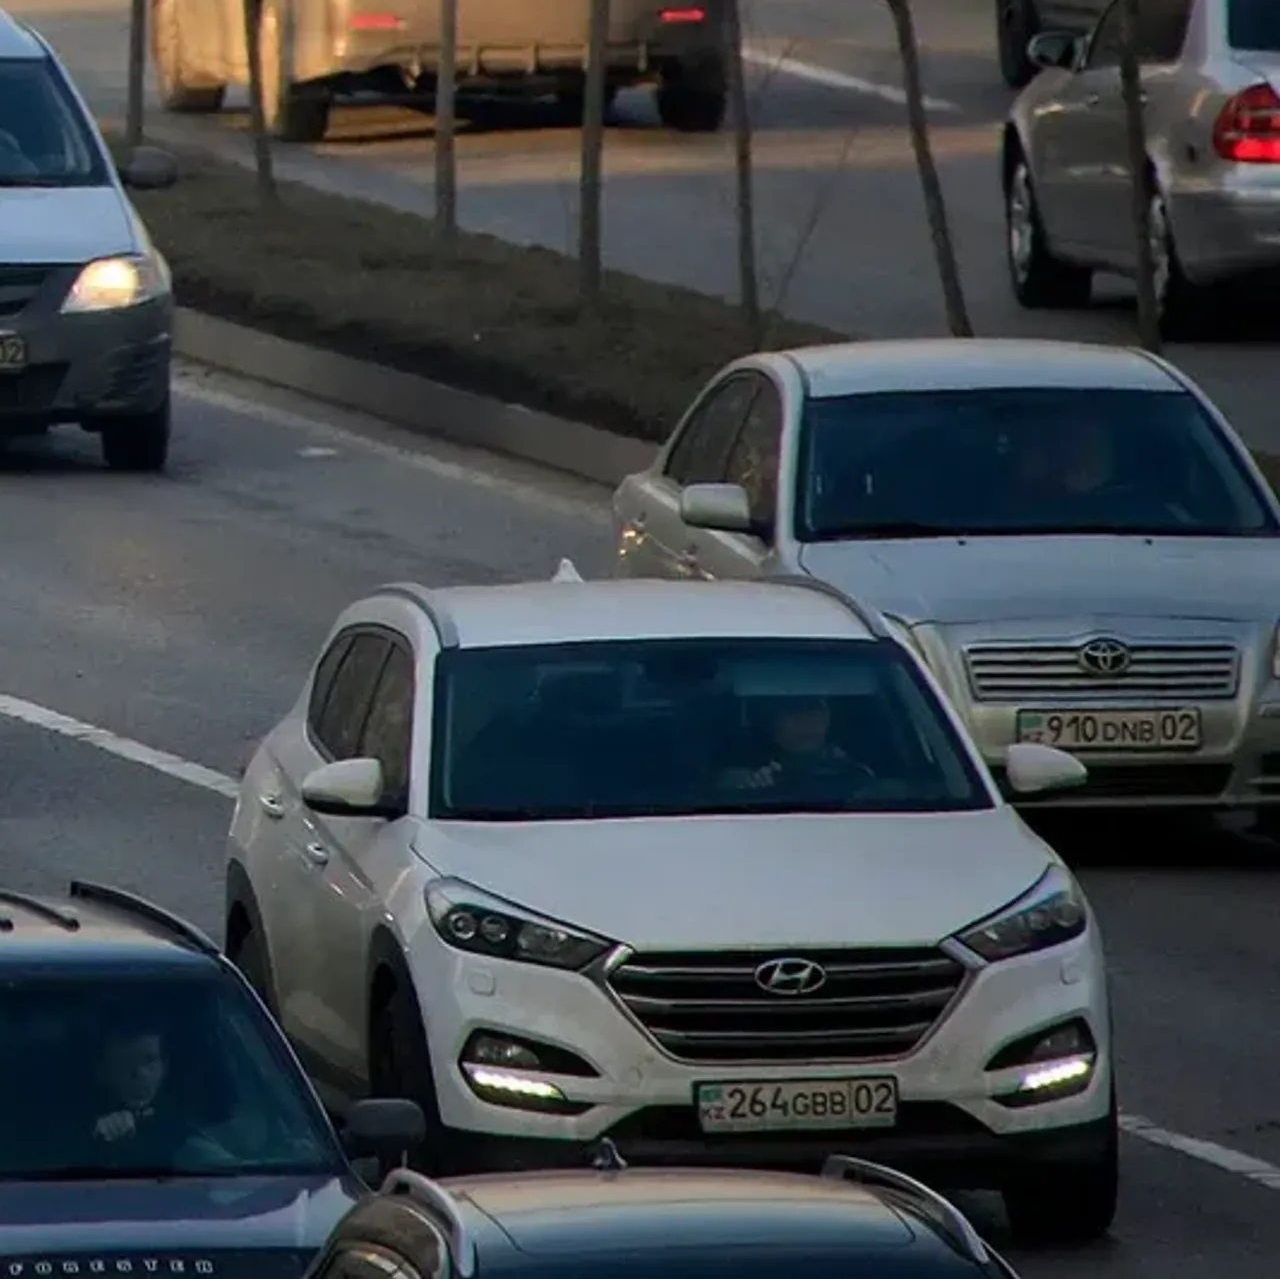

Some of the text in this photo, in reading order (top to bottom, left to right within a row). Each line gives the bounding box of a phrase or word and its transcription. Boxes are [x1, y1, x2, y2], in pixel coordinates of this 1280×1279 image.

[1047, 715, 1098, 742] 910
[1162, 713, 1196, 741] 02
[727, 1086, 788, 1117] 264
[855, 1083, 893, 1114] 02
